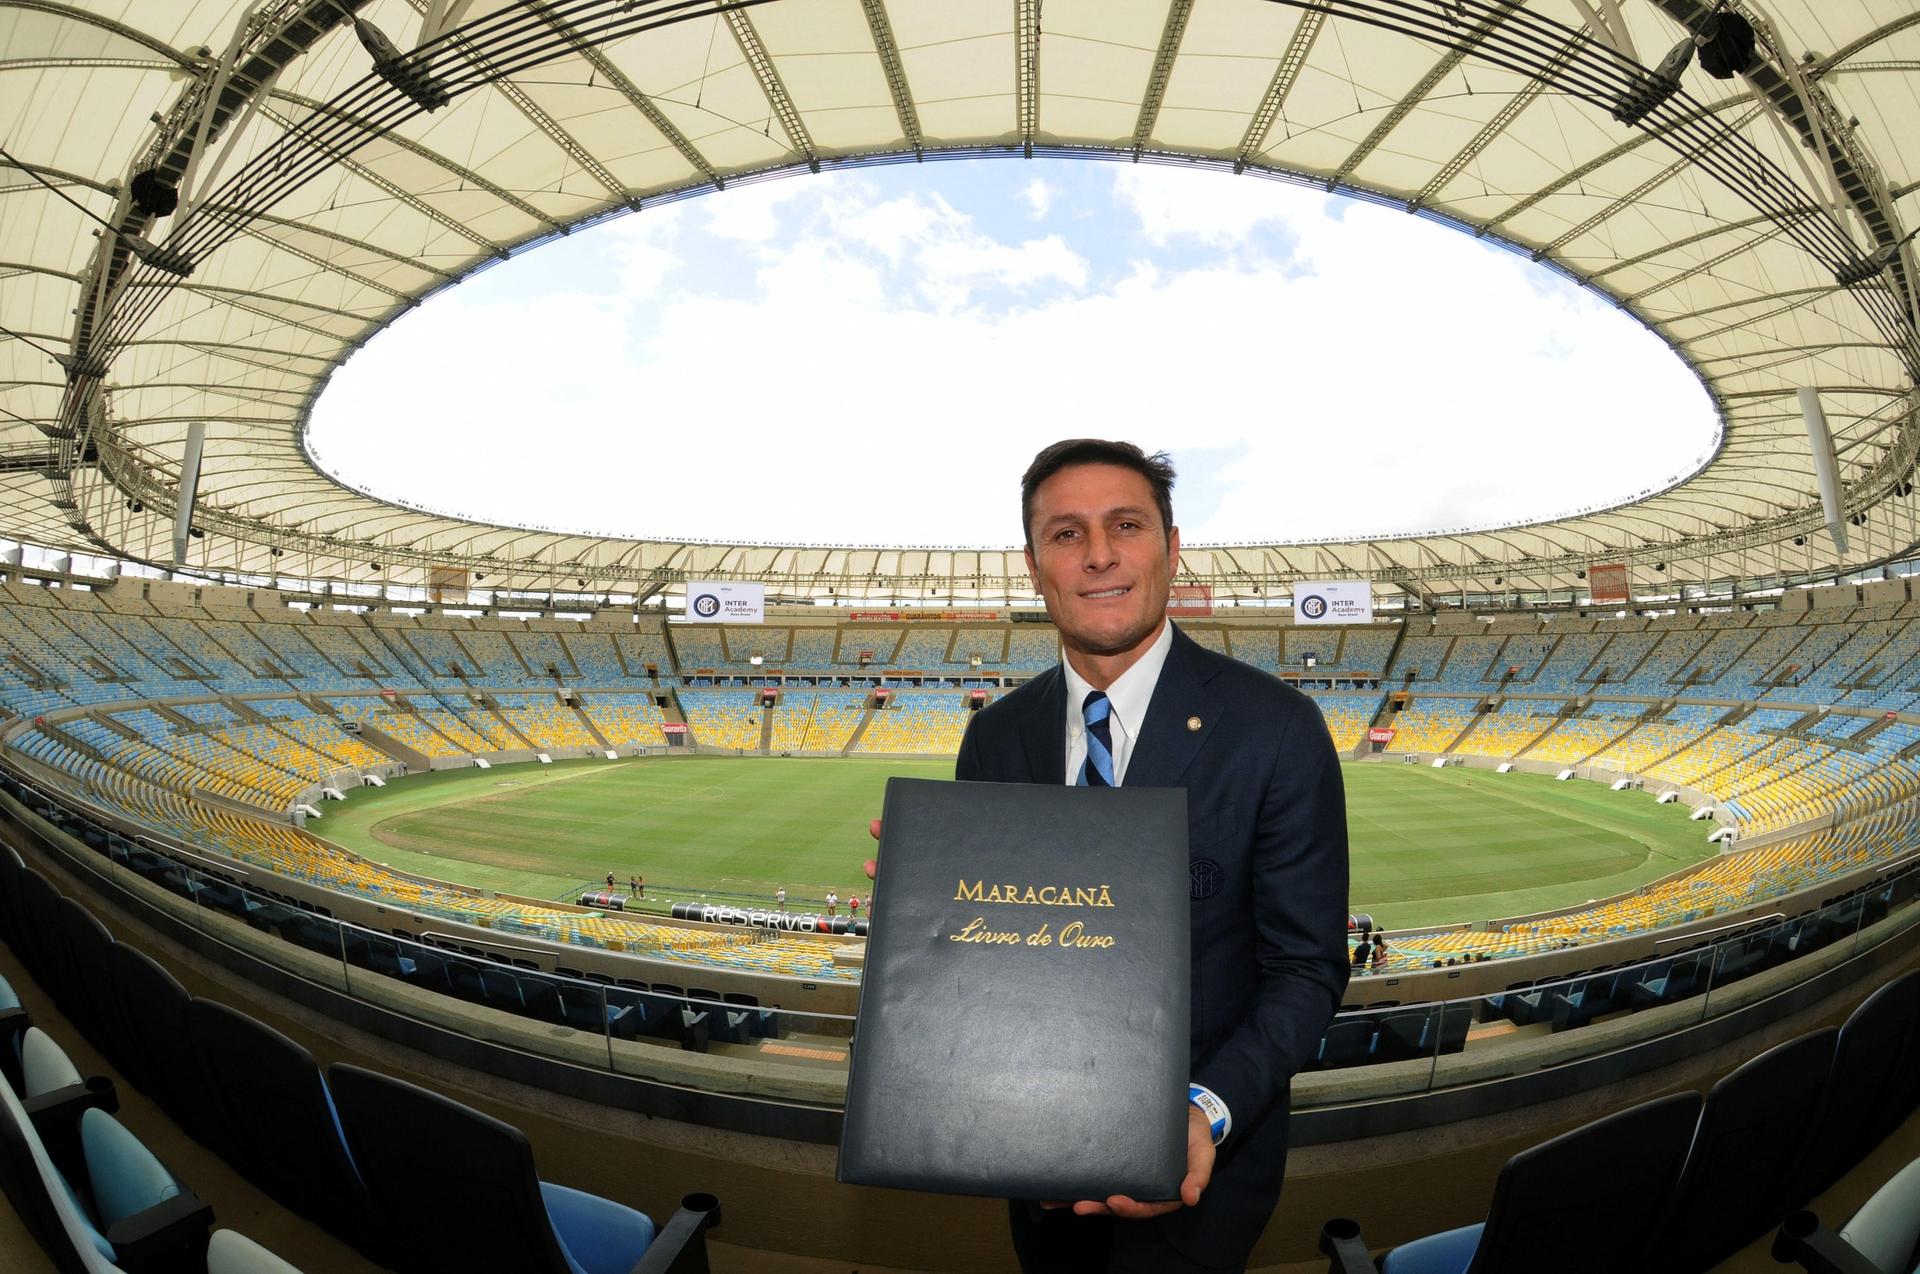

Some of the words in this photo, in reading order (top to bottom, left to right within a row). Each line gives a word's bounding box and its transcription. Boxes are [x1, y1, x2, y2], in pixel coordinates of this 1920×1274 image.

[950, 917, 1021, 945] Livro
[1026, 923, 1052, 946] de
[1059, 921, 1115, 948] Ouro
